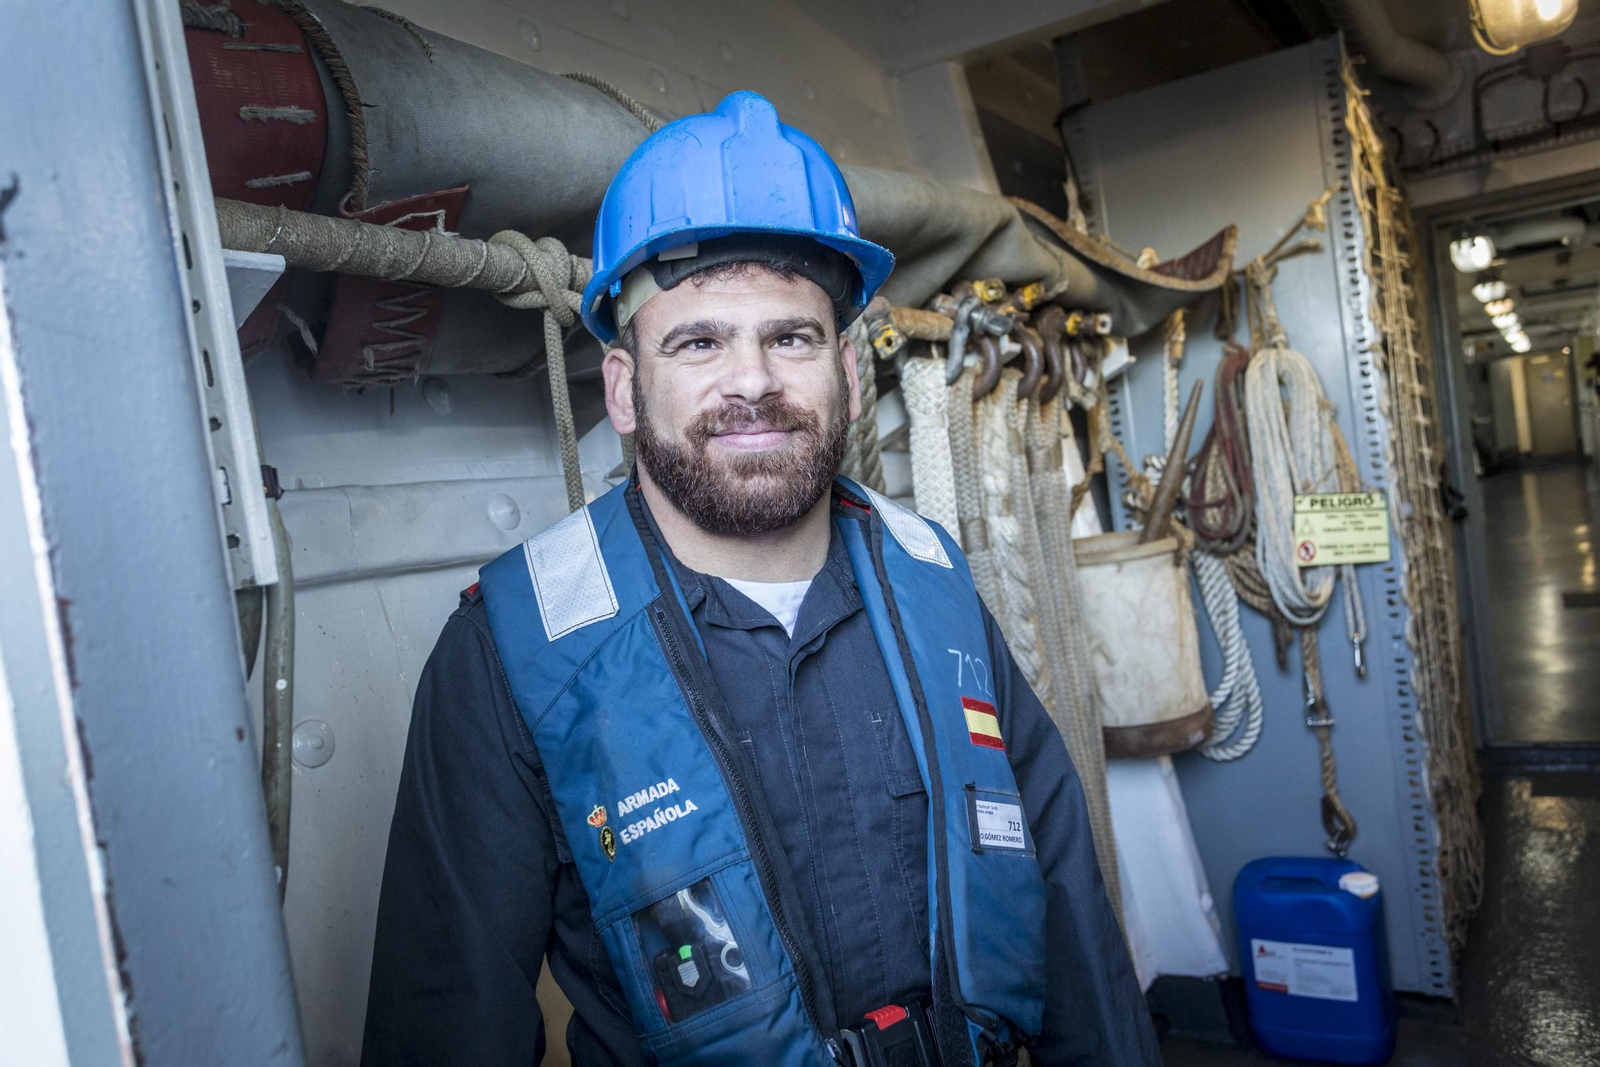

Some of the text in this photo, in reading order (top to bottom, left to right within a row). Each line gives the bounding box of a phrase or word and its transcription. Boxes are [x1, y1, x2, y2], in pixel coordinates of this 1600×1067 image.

[1310, 497, 1374, 507] PELIGRO
[947, 648, 993, 698] 712
[617, 777, 681, 818] ARMADA
[619, 799, 699, 845] ESPAÑOLA
[1008, 820, 1021, 832] 712
[985, 832, 1002, 842] GÓMEZ
[1002, 835, 1023, 844] ROMERO
